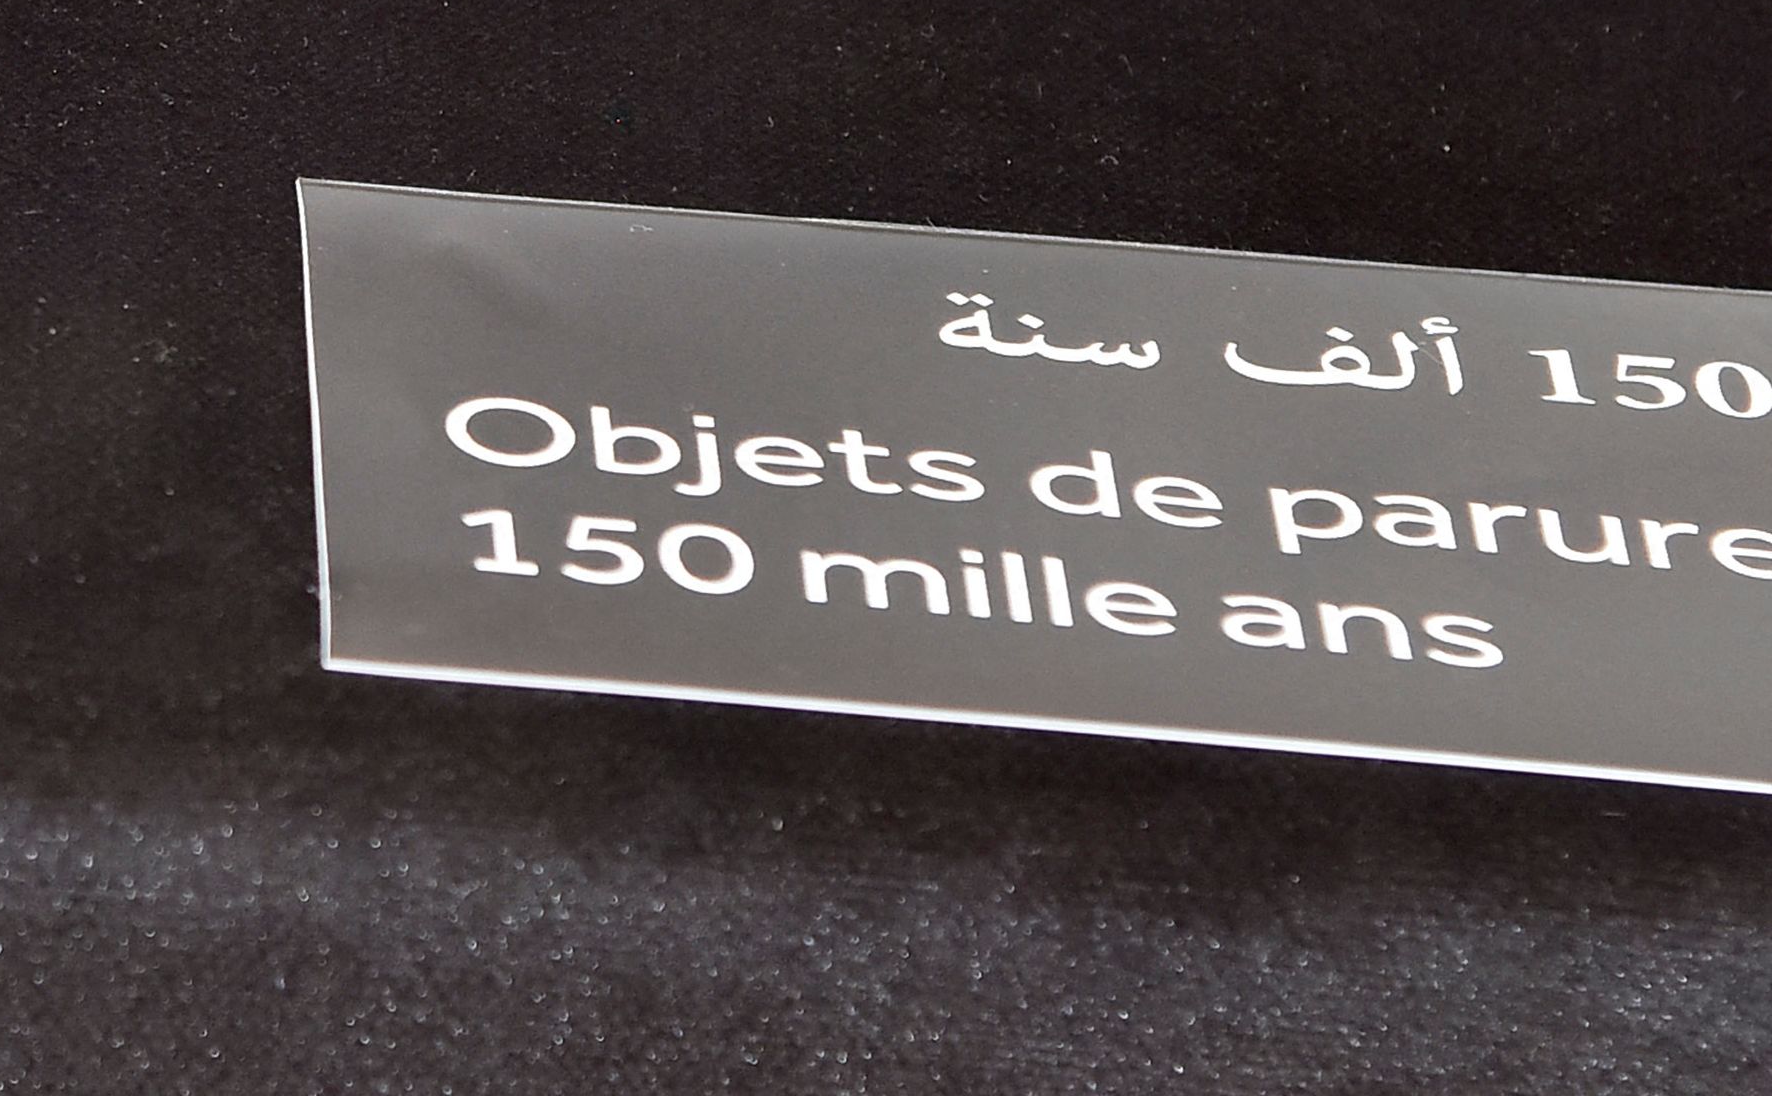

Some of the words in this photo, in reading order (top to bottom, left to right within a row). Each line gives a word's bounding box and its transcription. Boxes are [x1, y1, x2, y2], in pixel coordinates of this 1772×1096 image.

[937, 291, 1162, 370] سنة
[1223, 315, 1464, 396] ألف
[1527, 348, 1772, 420] 150
[444, 396, 986, 503] Objets
[1028, 449, 1224, 529] de
[1268, 486, 1772, 581] parure
[461, 508, 756, 596] 150
[799, 548, 1178, 637] mille
[1220, 594, 1505, 669] ans
